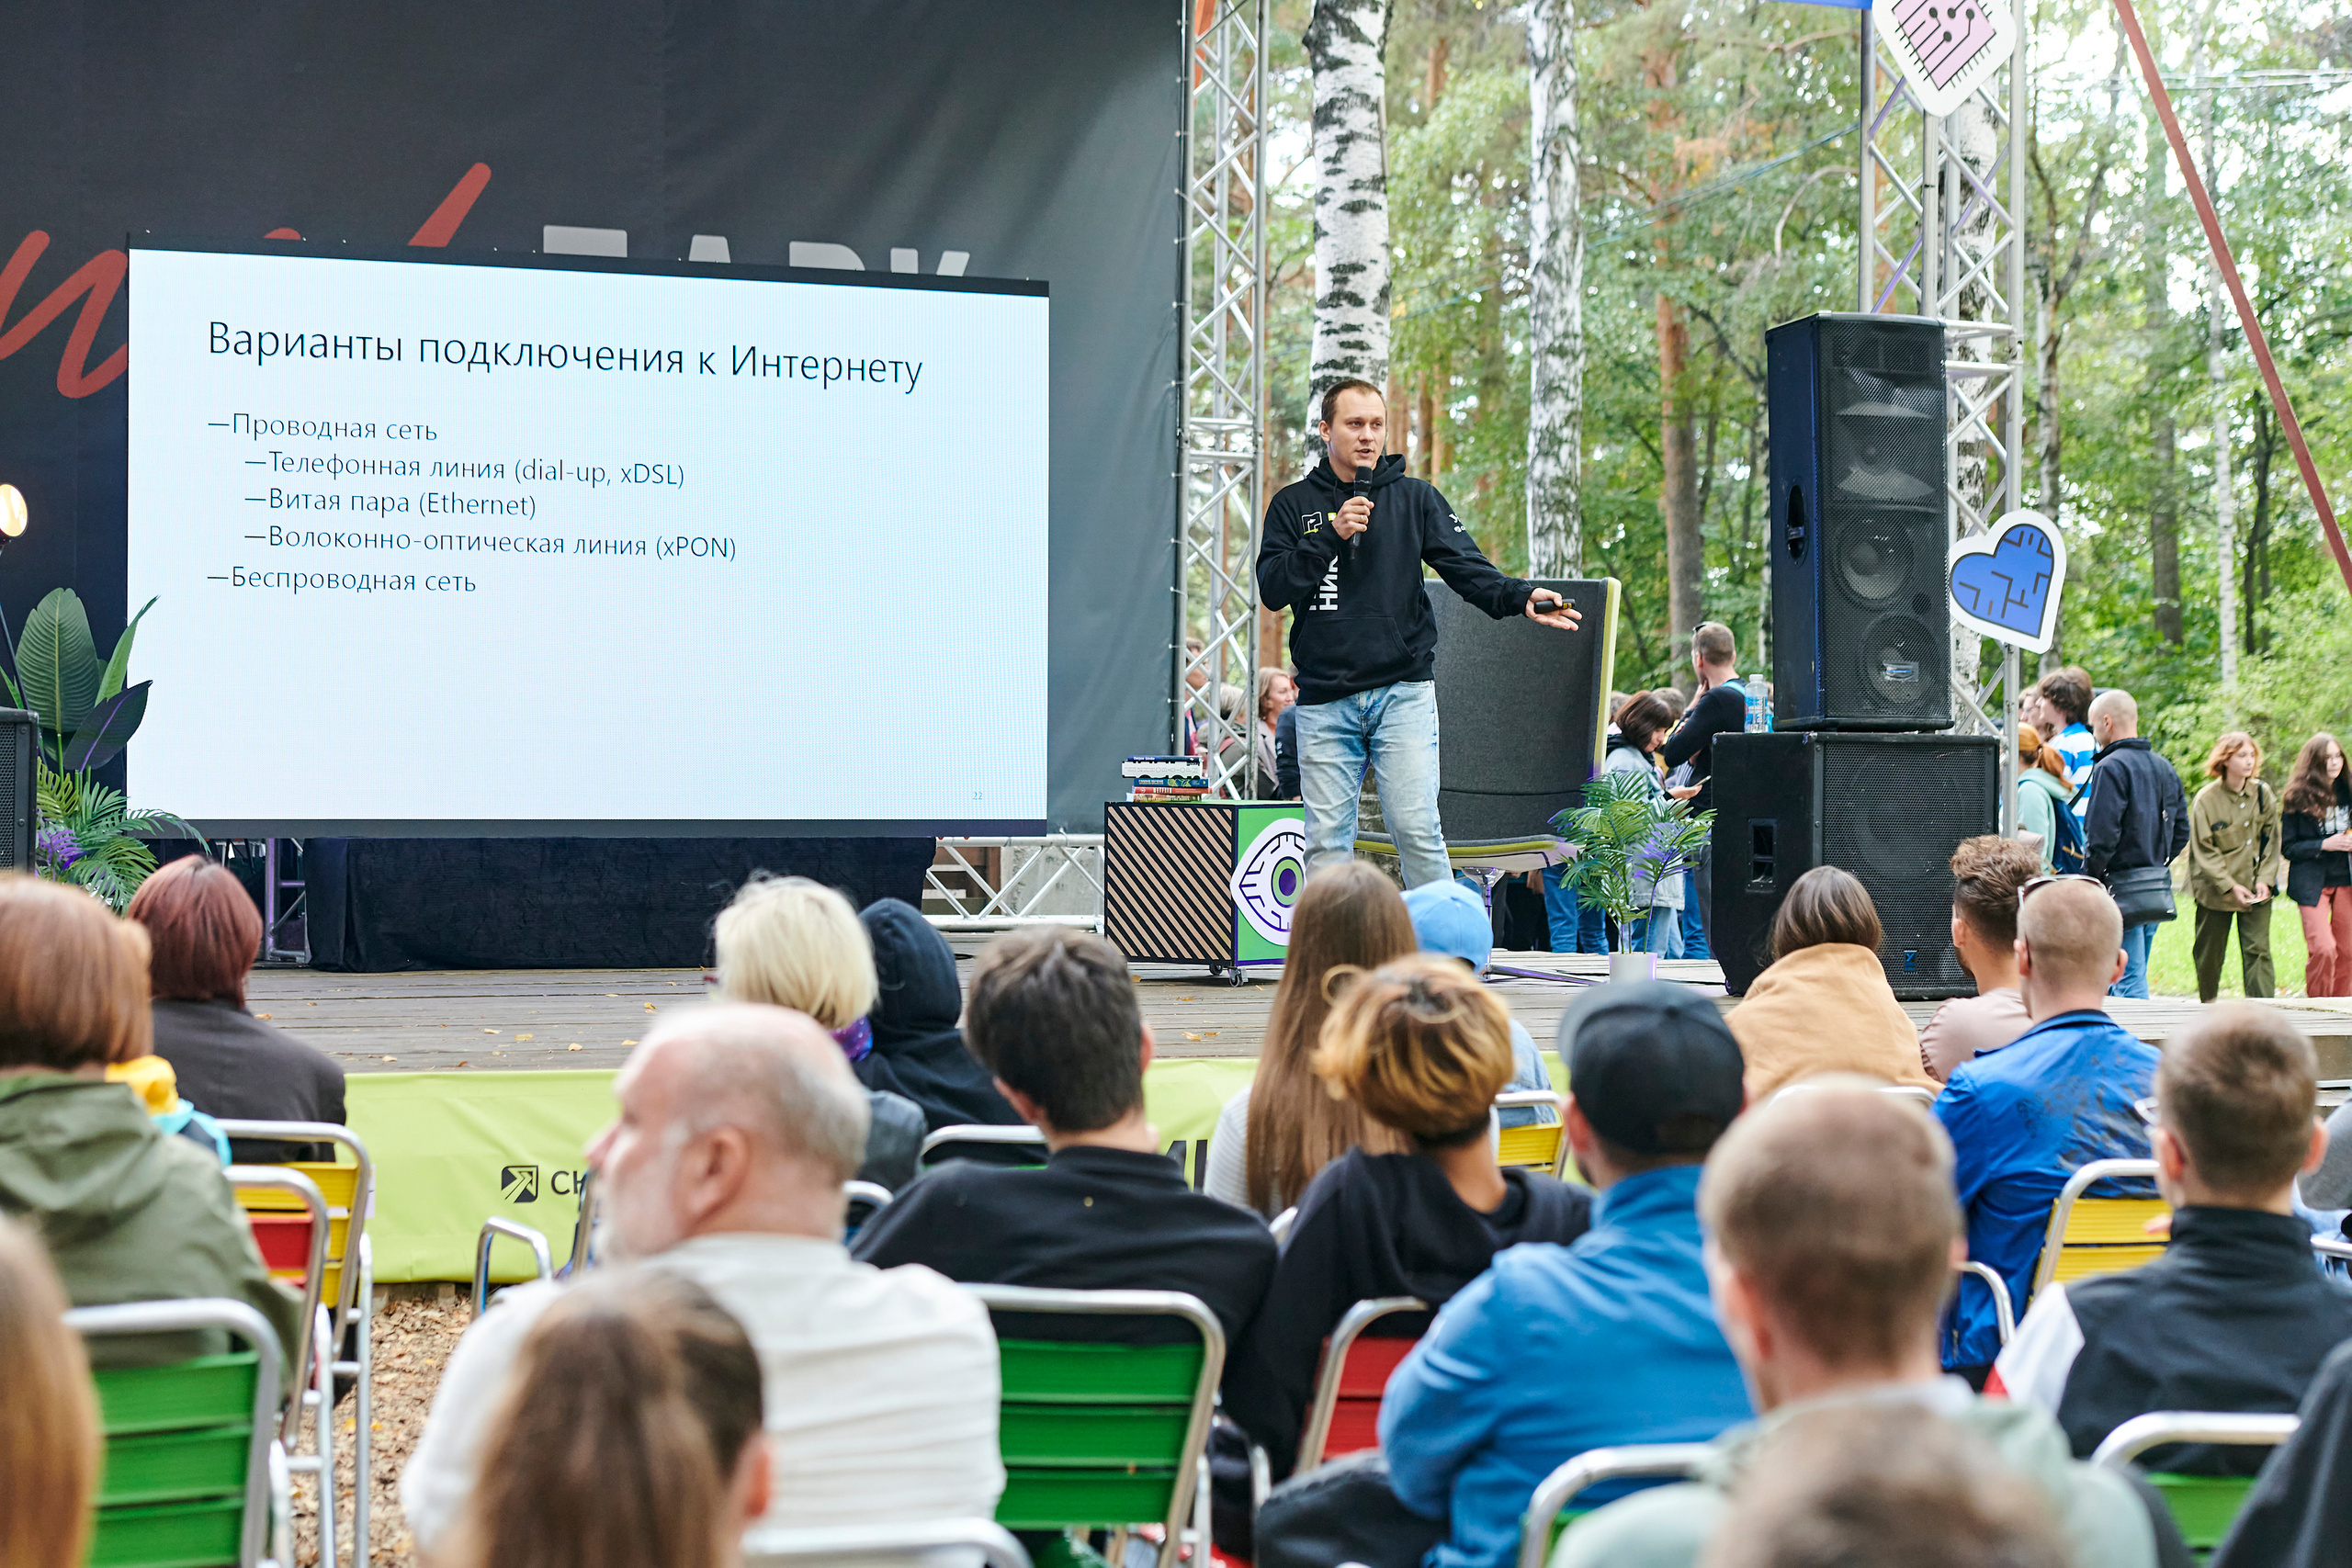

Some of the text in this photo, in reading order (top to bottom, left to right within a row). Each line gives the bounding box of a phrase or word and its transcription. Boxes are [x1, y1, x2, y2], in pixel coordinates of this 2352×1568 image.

[209, 321, 923, 395] Варианты подключения к Интернету
[386, 423, 438, 442] сеть
[429, 461, 504, 479] линия
[514, 457, 611, 489] (dial-up,
[620, 463, 684, 490] xDSL)
[351, 495, 409, 519] пара
[419, 491, 536, 521] (Ethernet)
[572, 538, 647, 557] линия
[656, 536, 736, 562] (xPON)
[424, 575, 477, 593] сеть
[972, 791, 984, 801] 22
